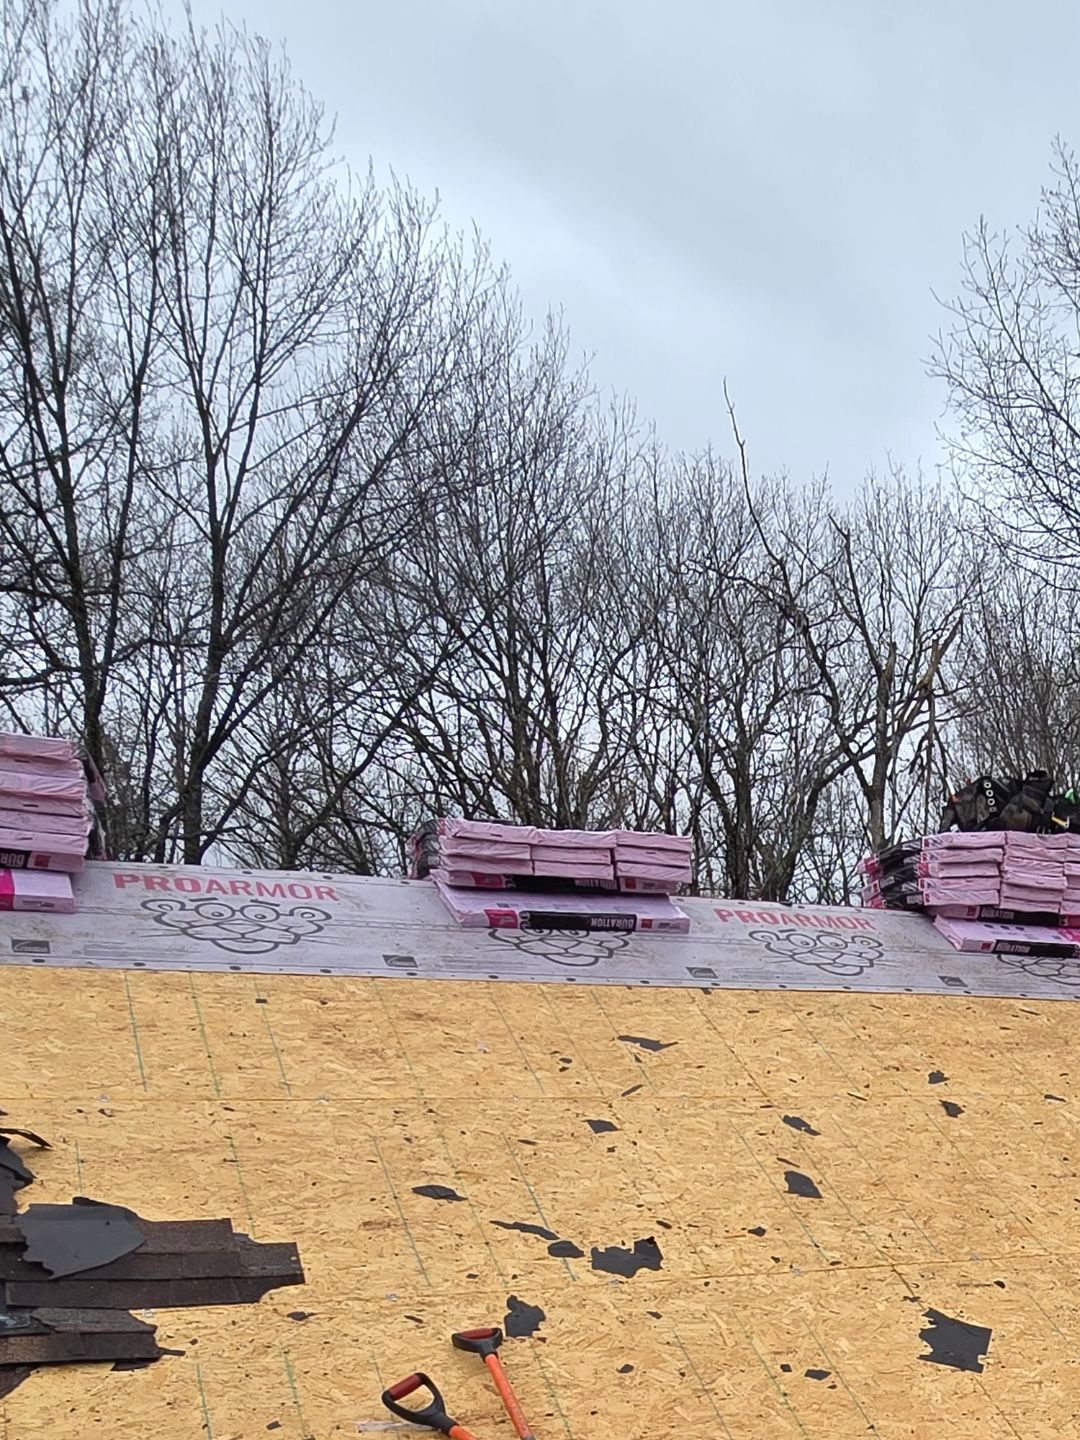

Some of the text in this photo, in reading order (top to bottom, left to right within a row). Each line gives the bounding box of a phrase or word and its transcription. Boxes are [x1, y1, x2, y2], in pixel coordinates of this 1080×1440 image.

[112, 873, 339, 901] PROARMOR
[590, 918, 634, 929] DURATION
[713, 908, 877, 930] PROARMOR
